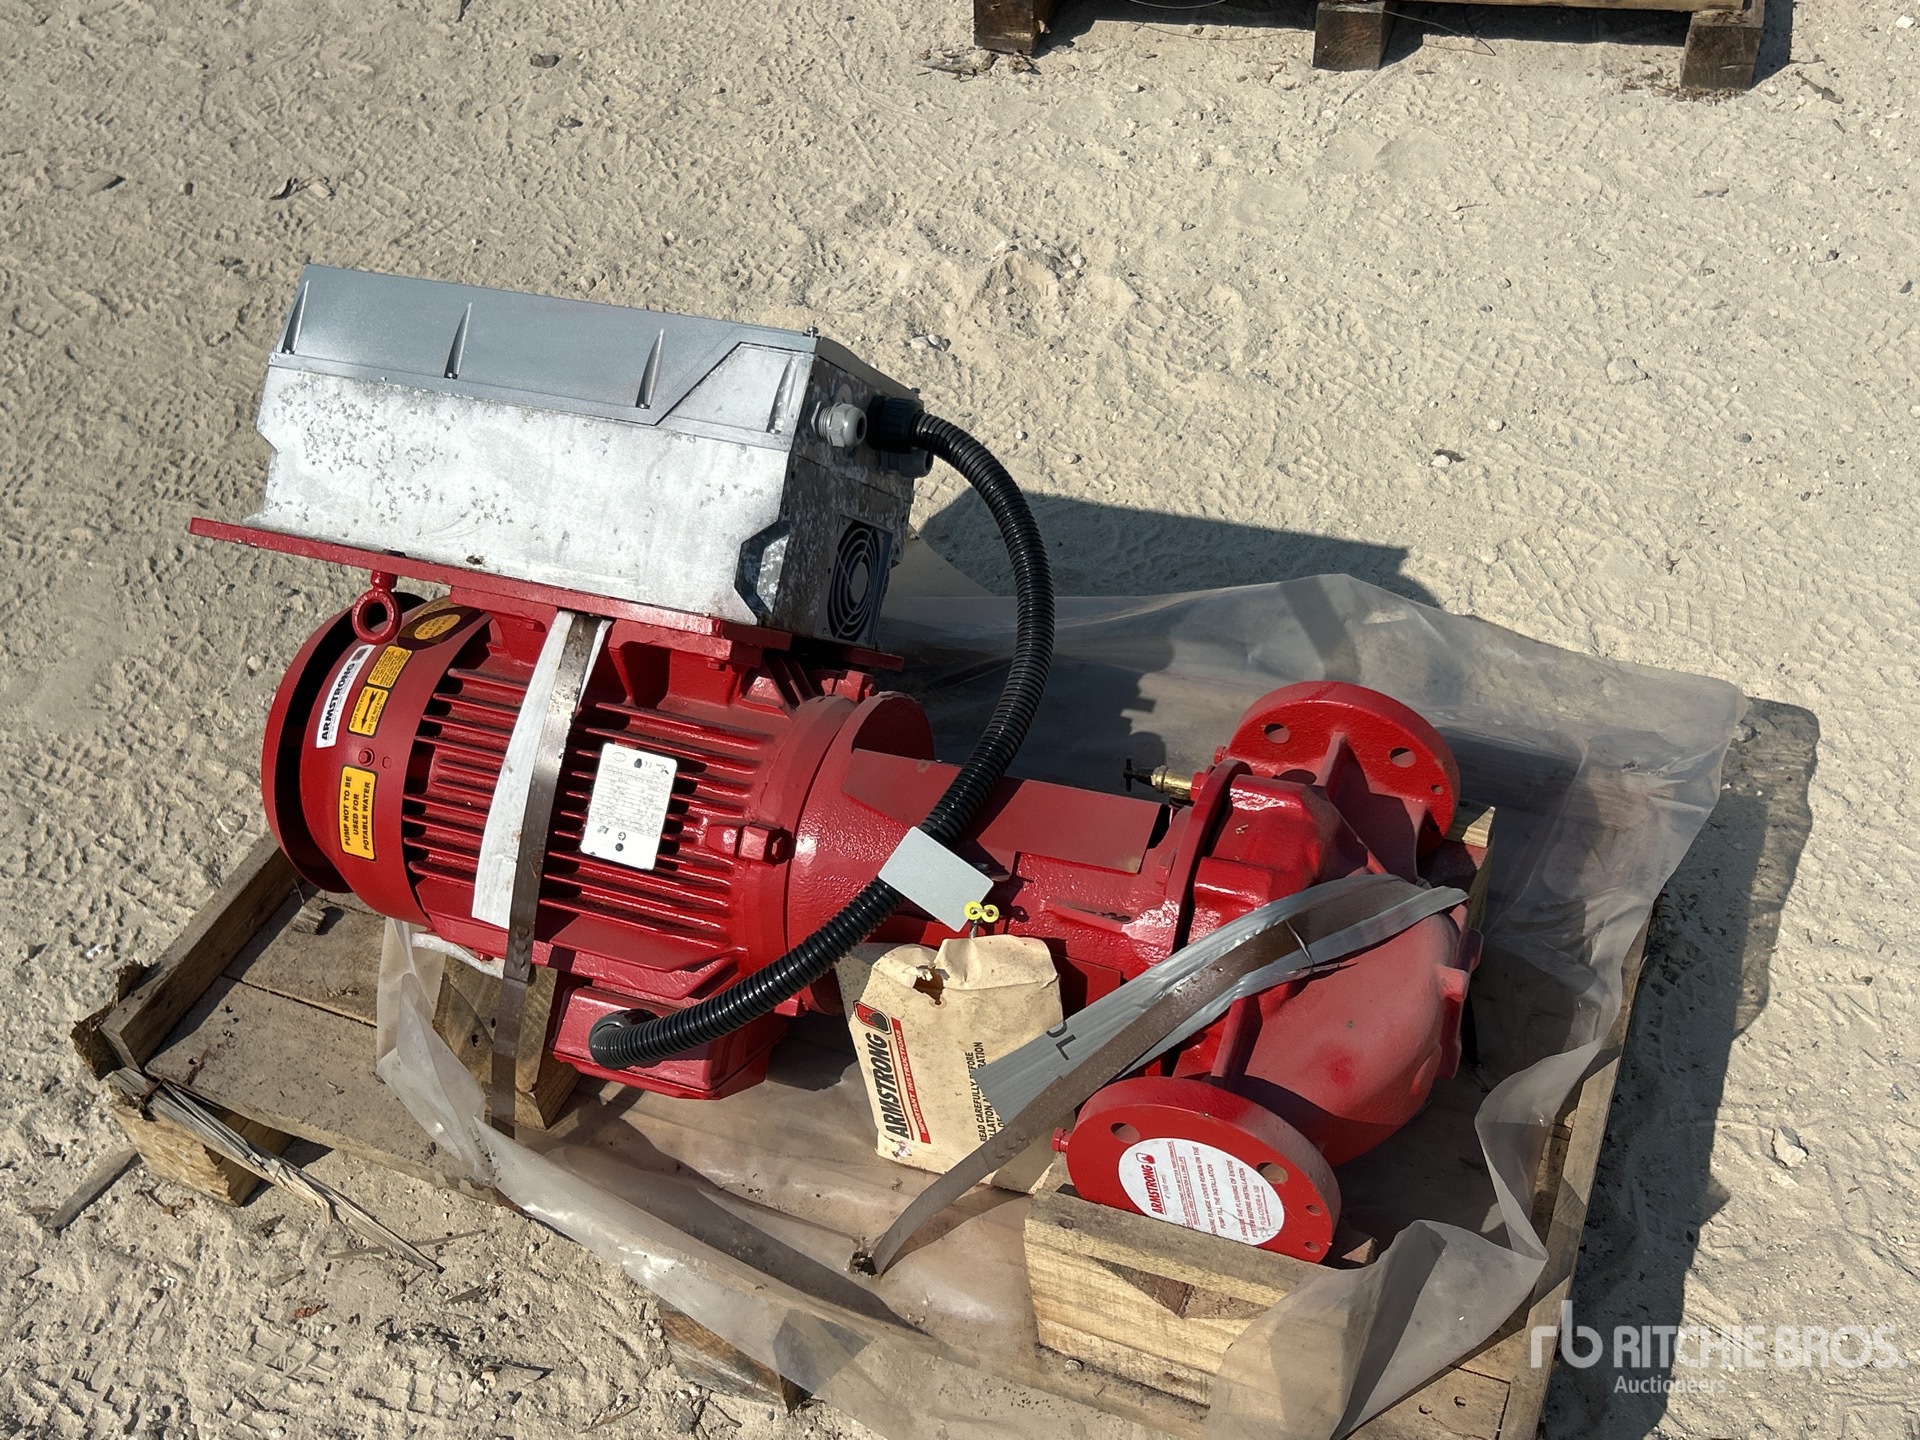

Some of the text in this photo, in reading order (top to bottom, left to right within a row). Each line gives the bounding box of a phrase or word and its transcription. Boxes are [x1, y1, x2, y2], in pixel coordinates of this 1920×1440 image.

[322, 662, 356, 741] ARMSTRONG
[356, 689, 368, 713] ROTATION
[373, 692, 385, 715] ROTATION
[345, 776, 351, 788] BE
[344, 790, 349, 801] TO
[974, 1042, 986, 1068] RATION
[865, 1032, 910, 1140] ARMSTRONG
[896, 1029, 927, 1133] IMPORTANT INSTRUCTIONS
[965, 1052, 988, 1141] READ CAREFULLY FORE
[1192, 1147, 1200, 1156] THE
[1197, 1165, 1206, 1182] REMAIN
[1226, 1160, 1235, 1177] ENTIRE
[1142, 1164, 1164, 1214] ARMSTRONG
[1183, 1180, 1192, 1199] OPERATION
[1207, 1164, 1219, 1196] INSTALLATION
[1201, 1184, 1209, 1199] COVER
[1232, 1186, 1242, 1208] FLUSHING
[1239, 1168, 1258, 1237] SYSTEM BEFORE INSTALLATION
[1180, 1193, 1189, 1217] INSTRUCTIONS
[1205, 1200, 1213, 1218] FLANGE
[1209, 1219, 1217, 1234] NSURE
[1239, 1219, 1247, 1236] ENSURE
